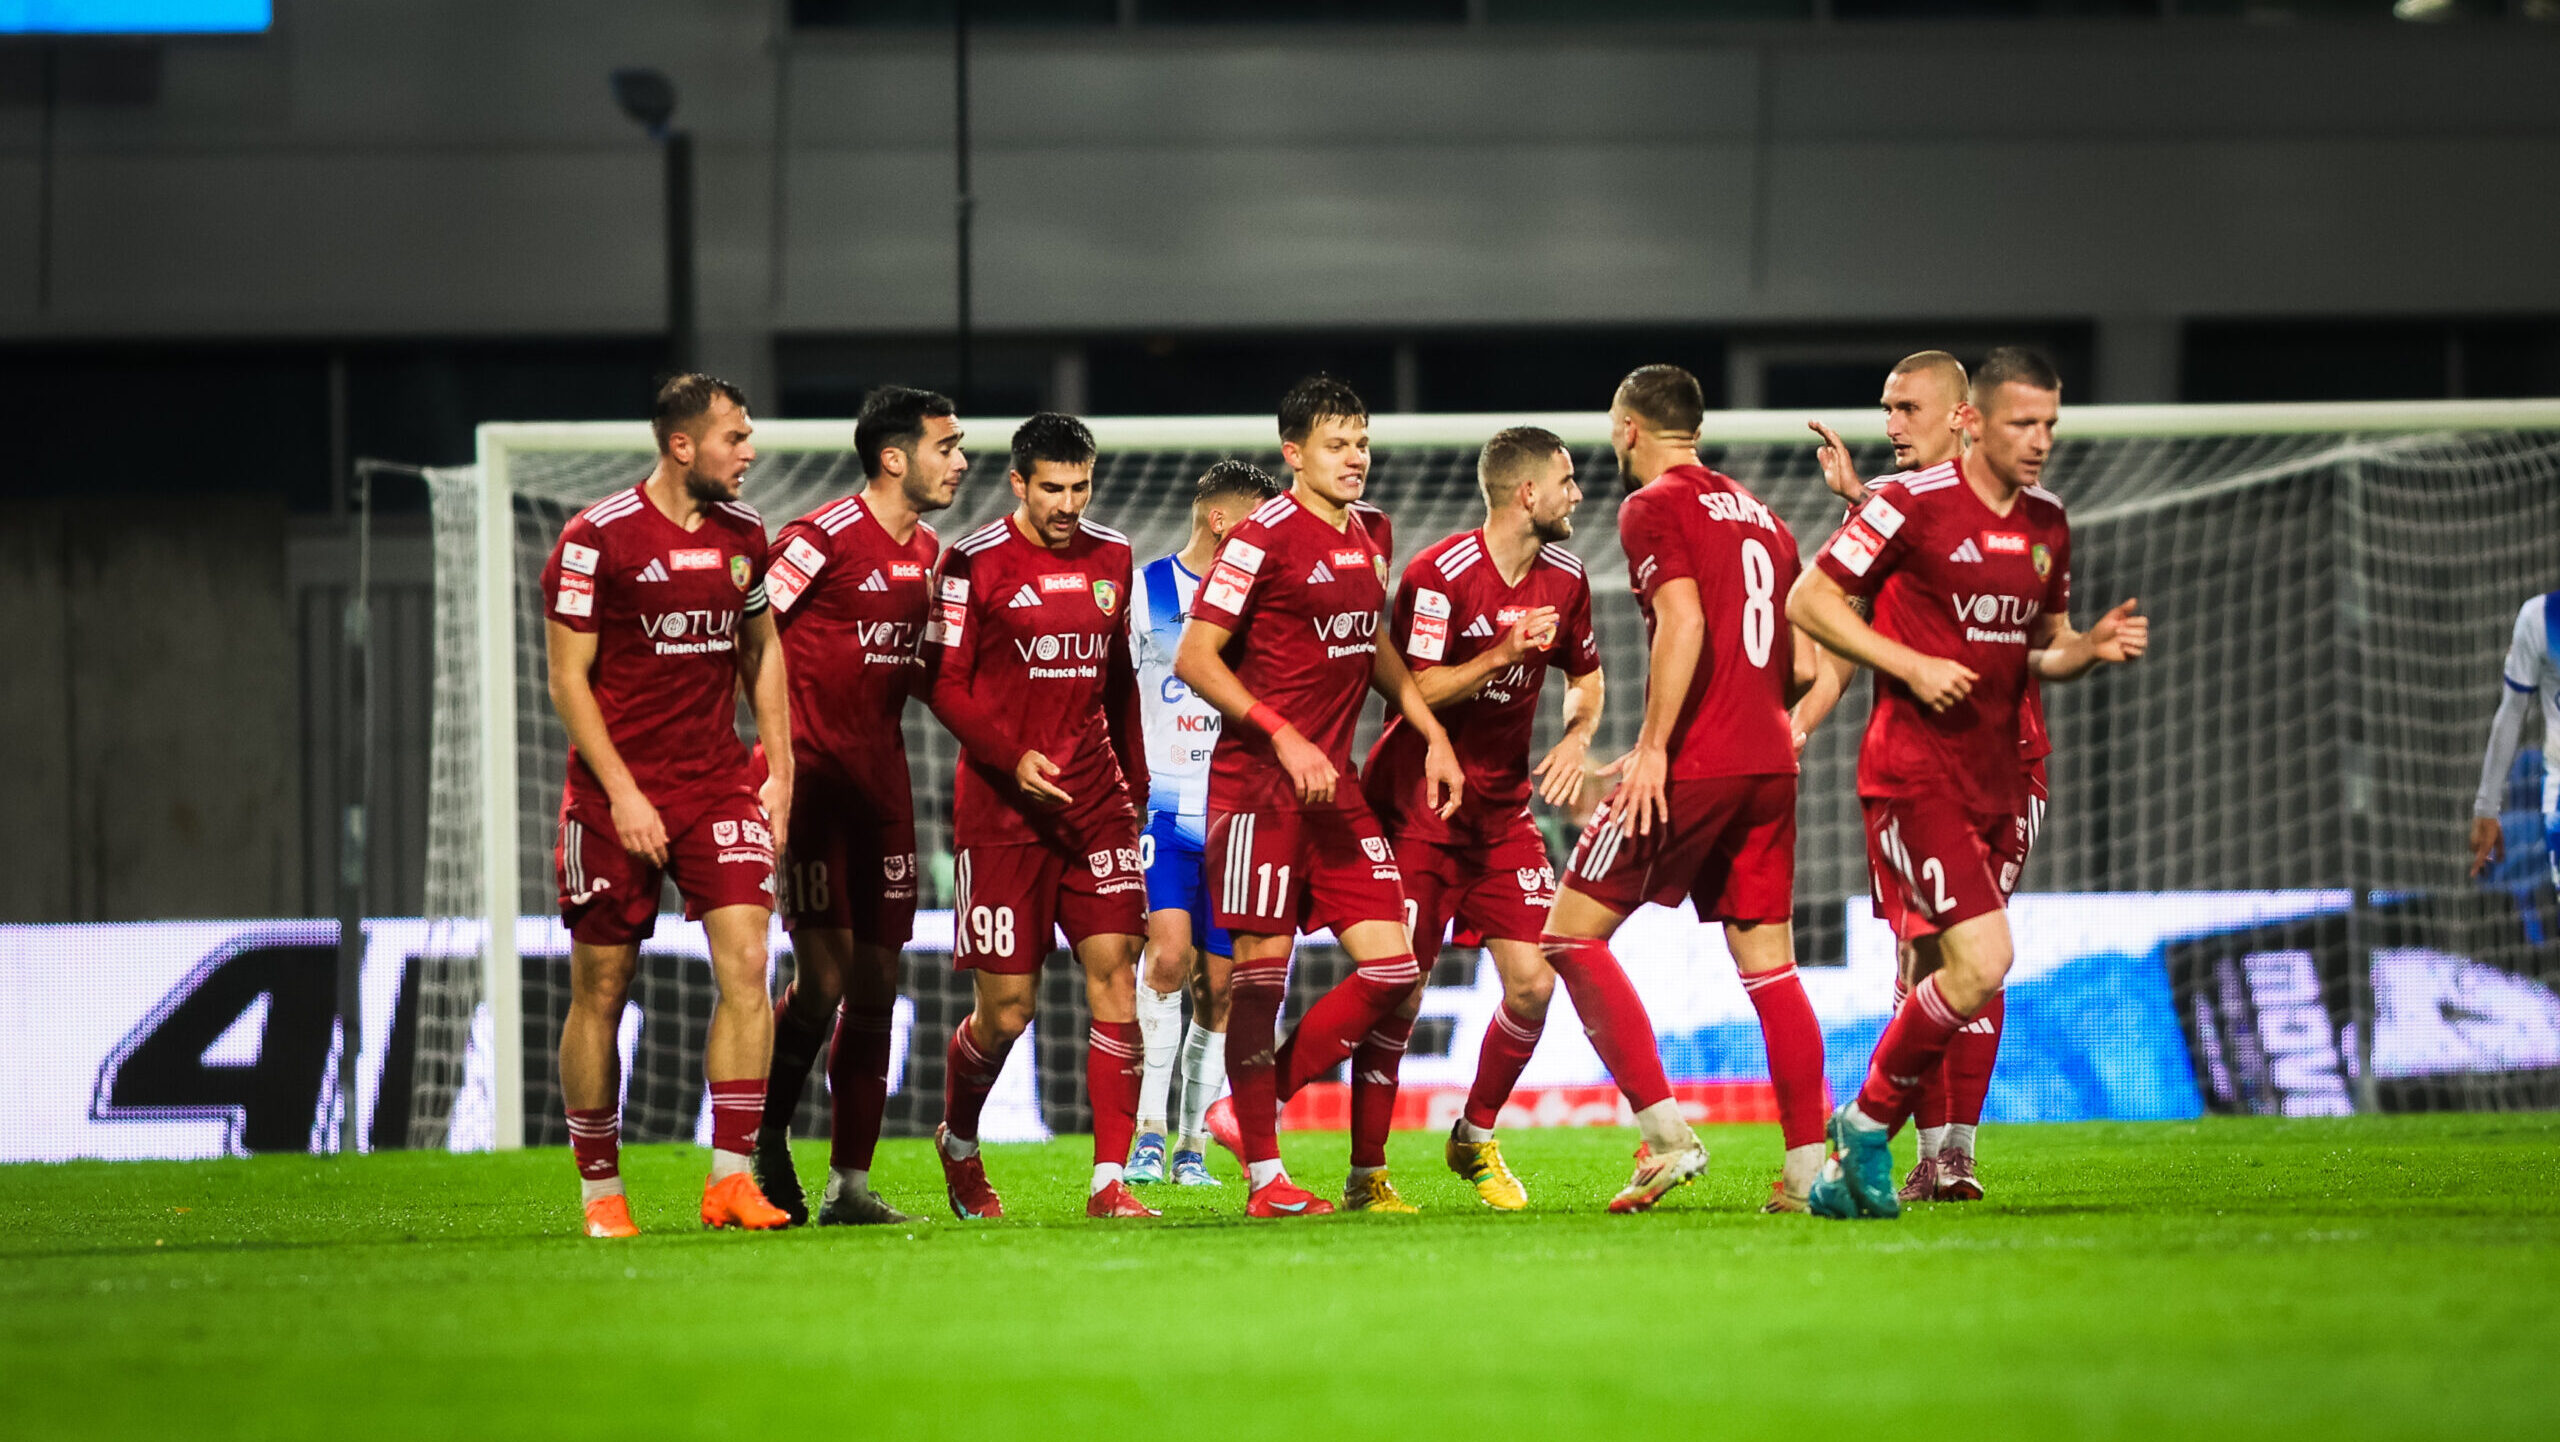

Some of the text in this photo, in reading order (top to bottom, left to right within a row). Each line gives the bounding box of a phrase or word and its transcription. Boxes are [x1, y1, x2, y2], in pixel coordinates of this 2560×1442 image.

[1044, 576, 1083, 591] Betclic
[1741, 537, 1775, 669] 8
[1029, 666, 1077, 680] Finance
[792, 860, 830, 912] 18
[1256, 862, 1290, 919] 11
[1922, 857, 1958, 914] 2
[971, 905, 1015, 958] 98
